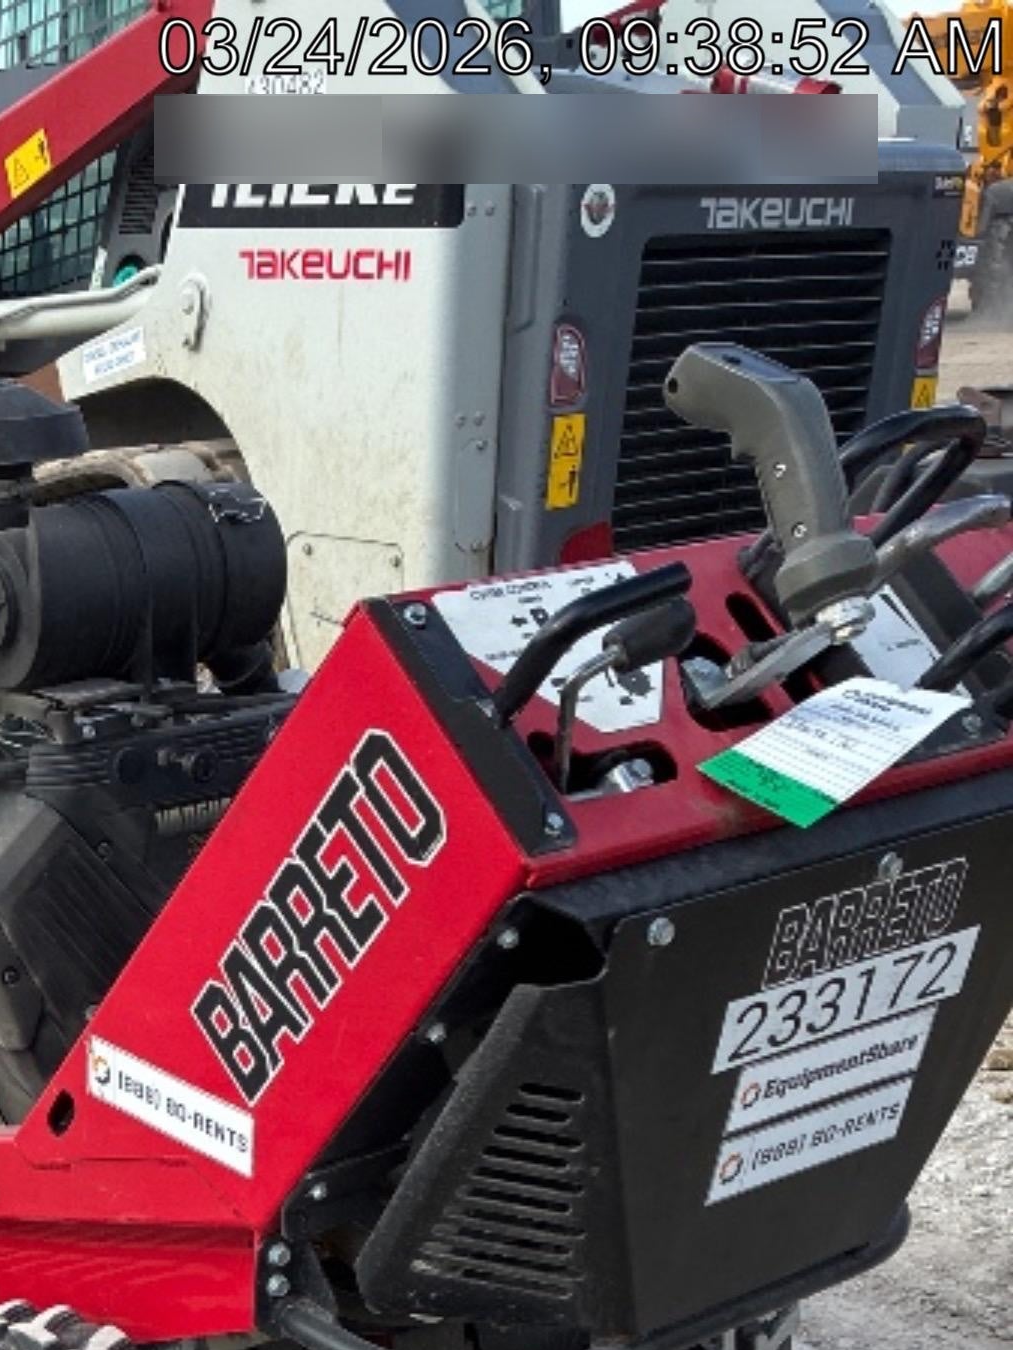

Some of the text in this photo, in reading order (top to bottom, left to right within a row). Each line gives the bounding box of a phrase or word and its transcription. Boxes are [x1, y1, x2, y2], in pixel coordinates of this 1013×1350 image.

[239, 249, 413, 282] TAKEUCHI
[189, 727, 449, 1109] BARRETO
[761, 856, 970, 991] BARRETO
[727, 941, 958, 1063] 233172
[763, 1034, 918, 1100] EquipmentShare
